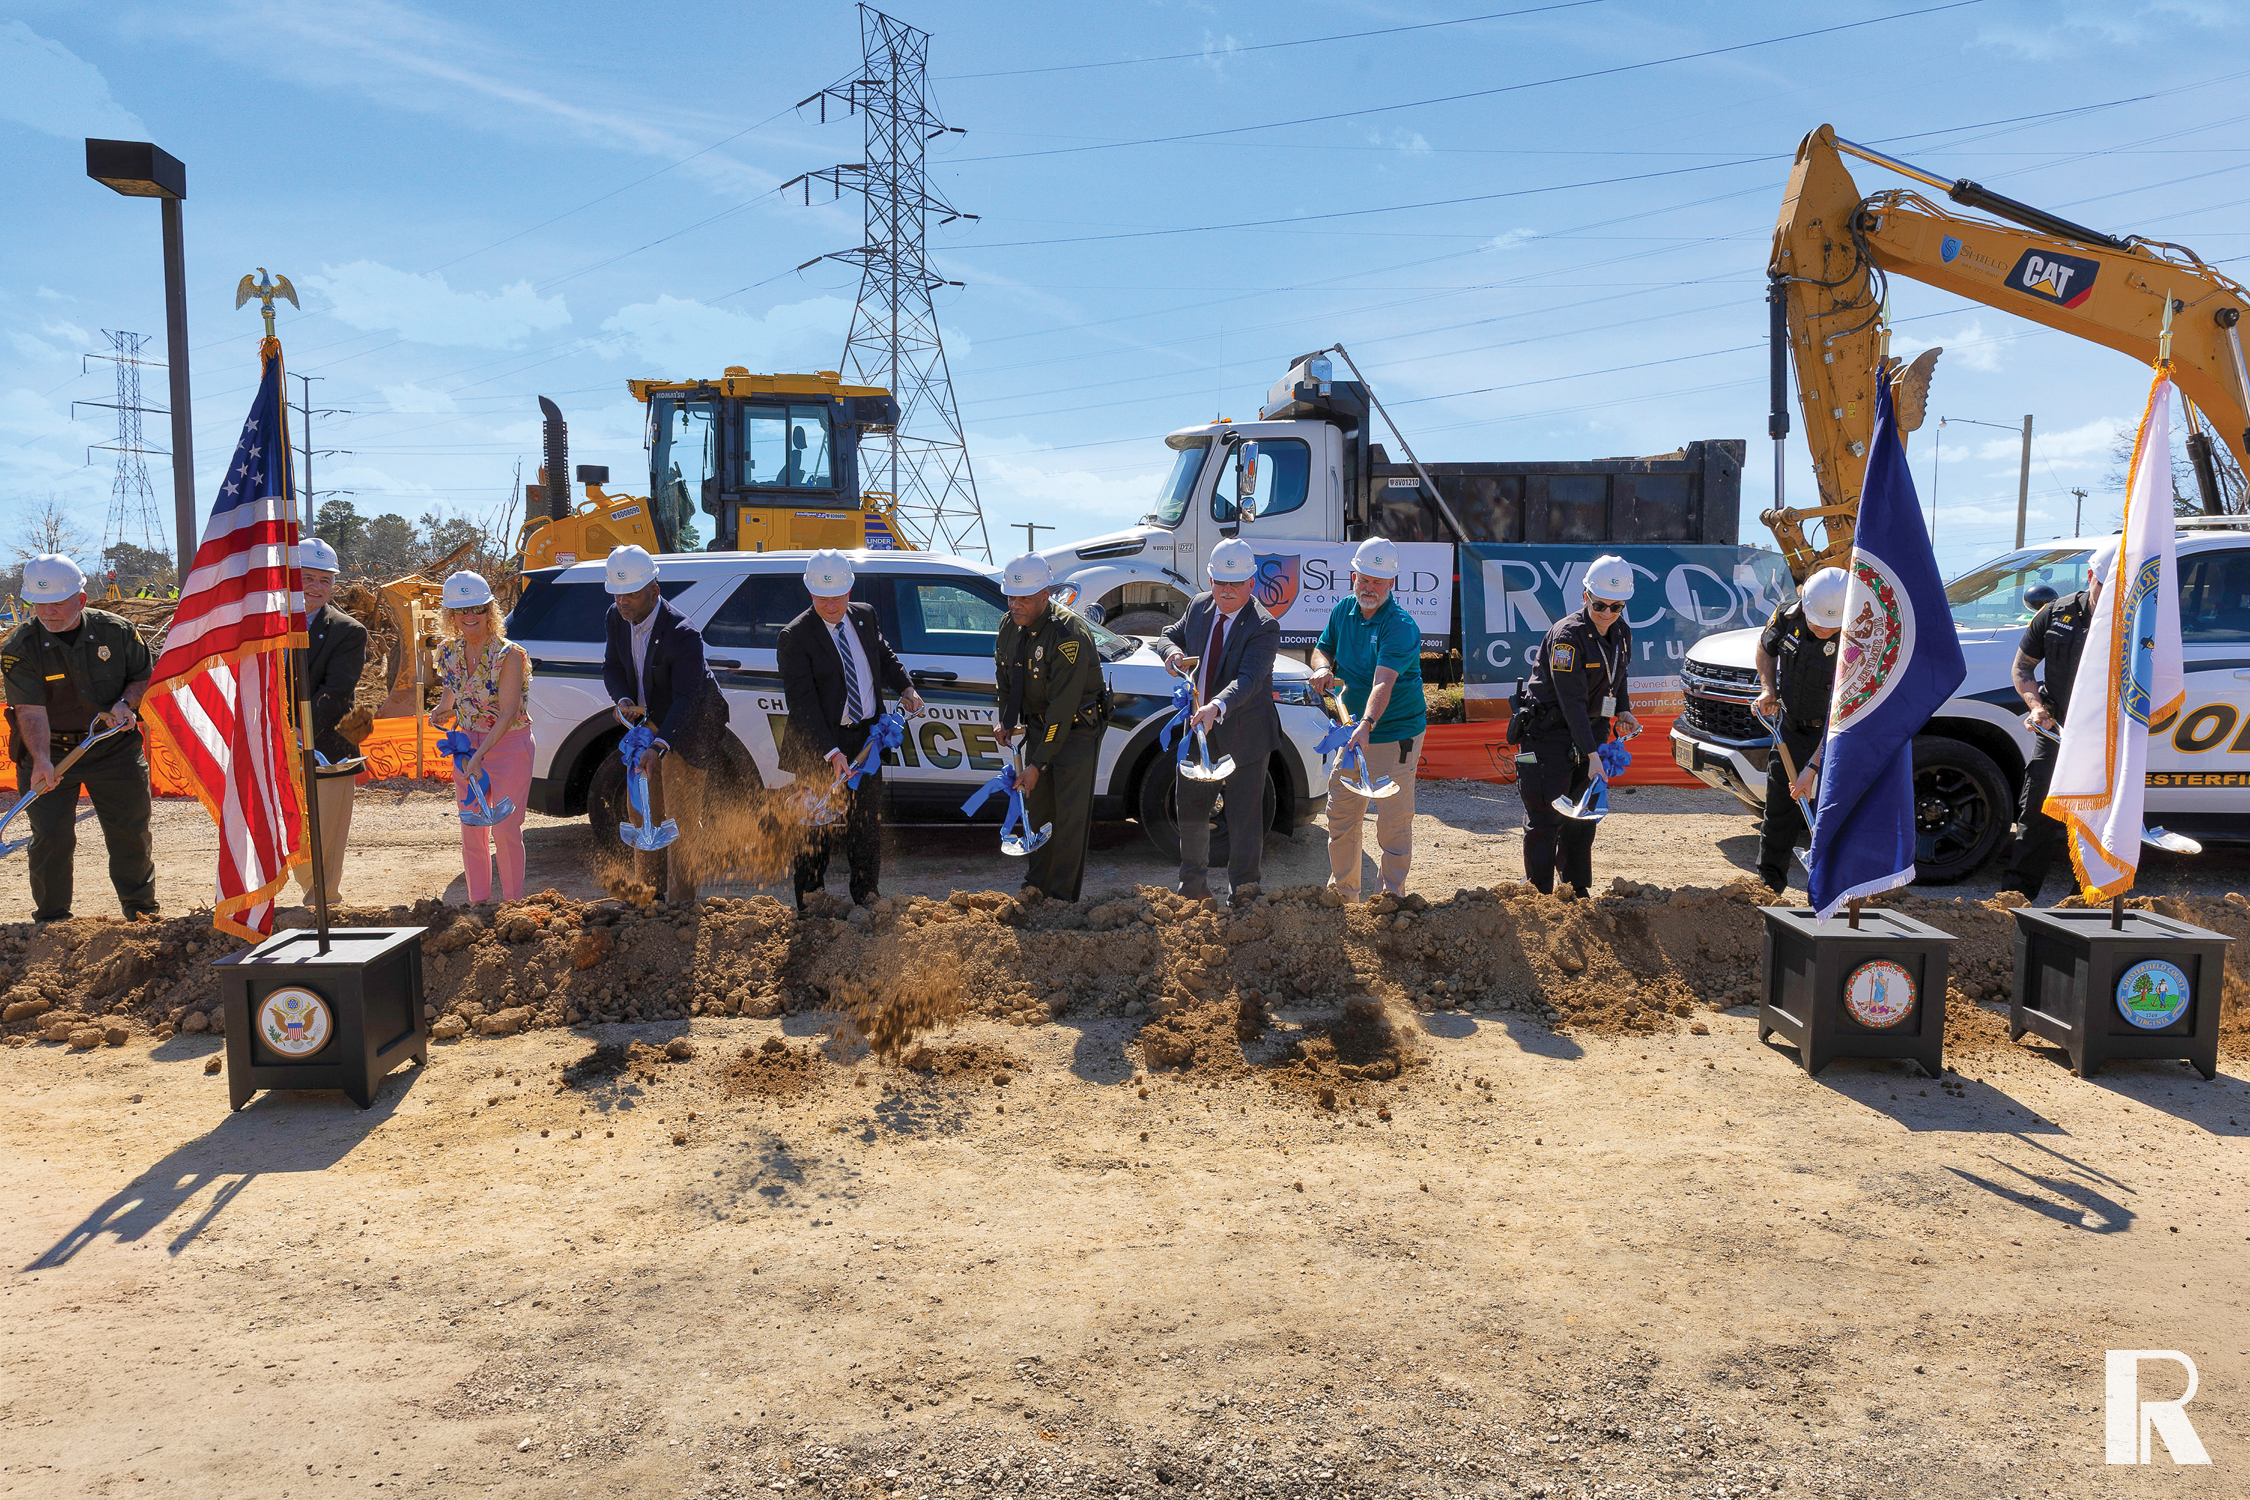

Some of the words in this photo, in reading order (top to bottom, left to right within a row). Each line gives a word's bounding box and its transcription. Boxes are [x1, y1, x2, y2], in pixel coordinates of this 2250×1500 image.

[1960, 244, 2009, 271] SHIELD
[2022, 255, 2075, 299] CAT
[656, 391, 686, 399] KOMATSU
[1394, 479, 1419, 487] 8V01210
[1302, 558, 1440, 593] SHLD
[1303, 594, 1439, 606] CONTING
[2053, 621, 2074, 631] POLICE
[1627, 680, 1669, 689] -Owned.
[1629, 698, 1684, 710] yconinc.co
[1868, 967, 1898, 977] VIRGINIA
[2122, 963, 2167, 990] CHESTERFIELD
[2167, 967, 2186, 991] COUNTY
[2135, 1016, 2169, 1026] VIRGINIA
